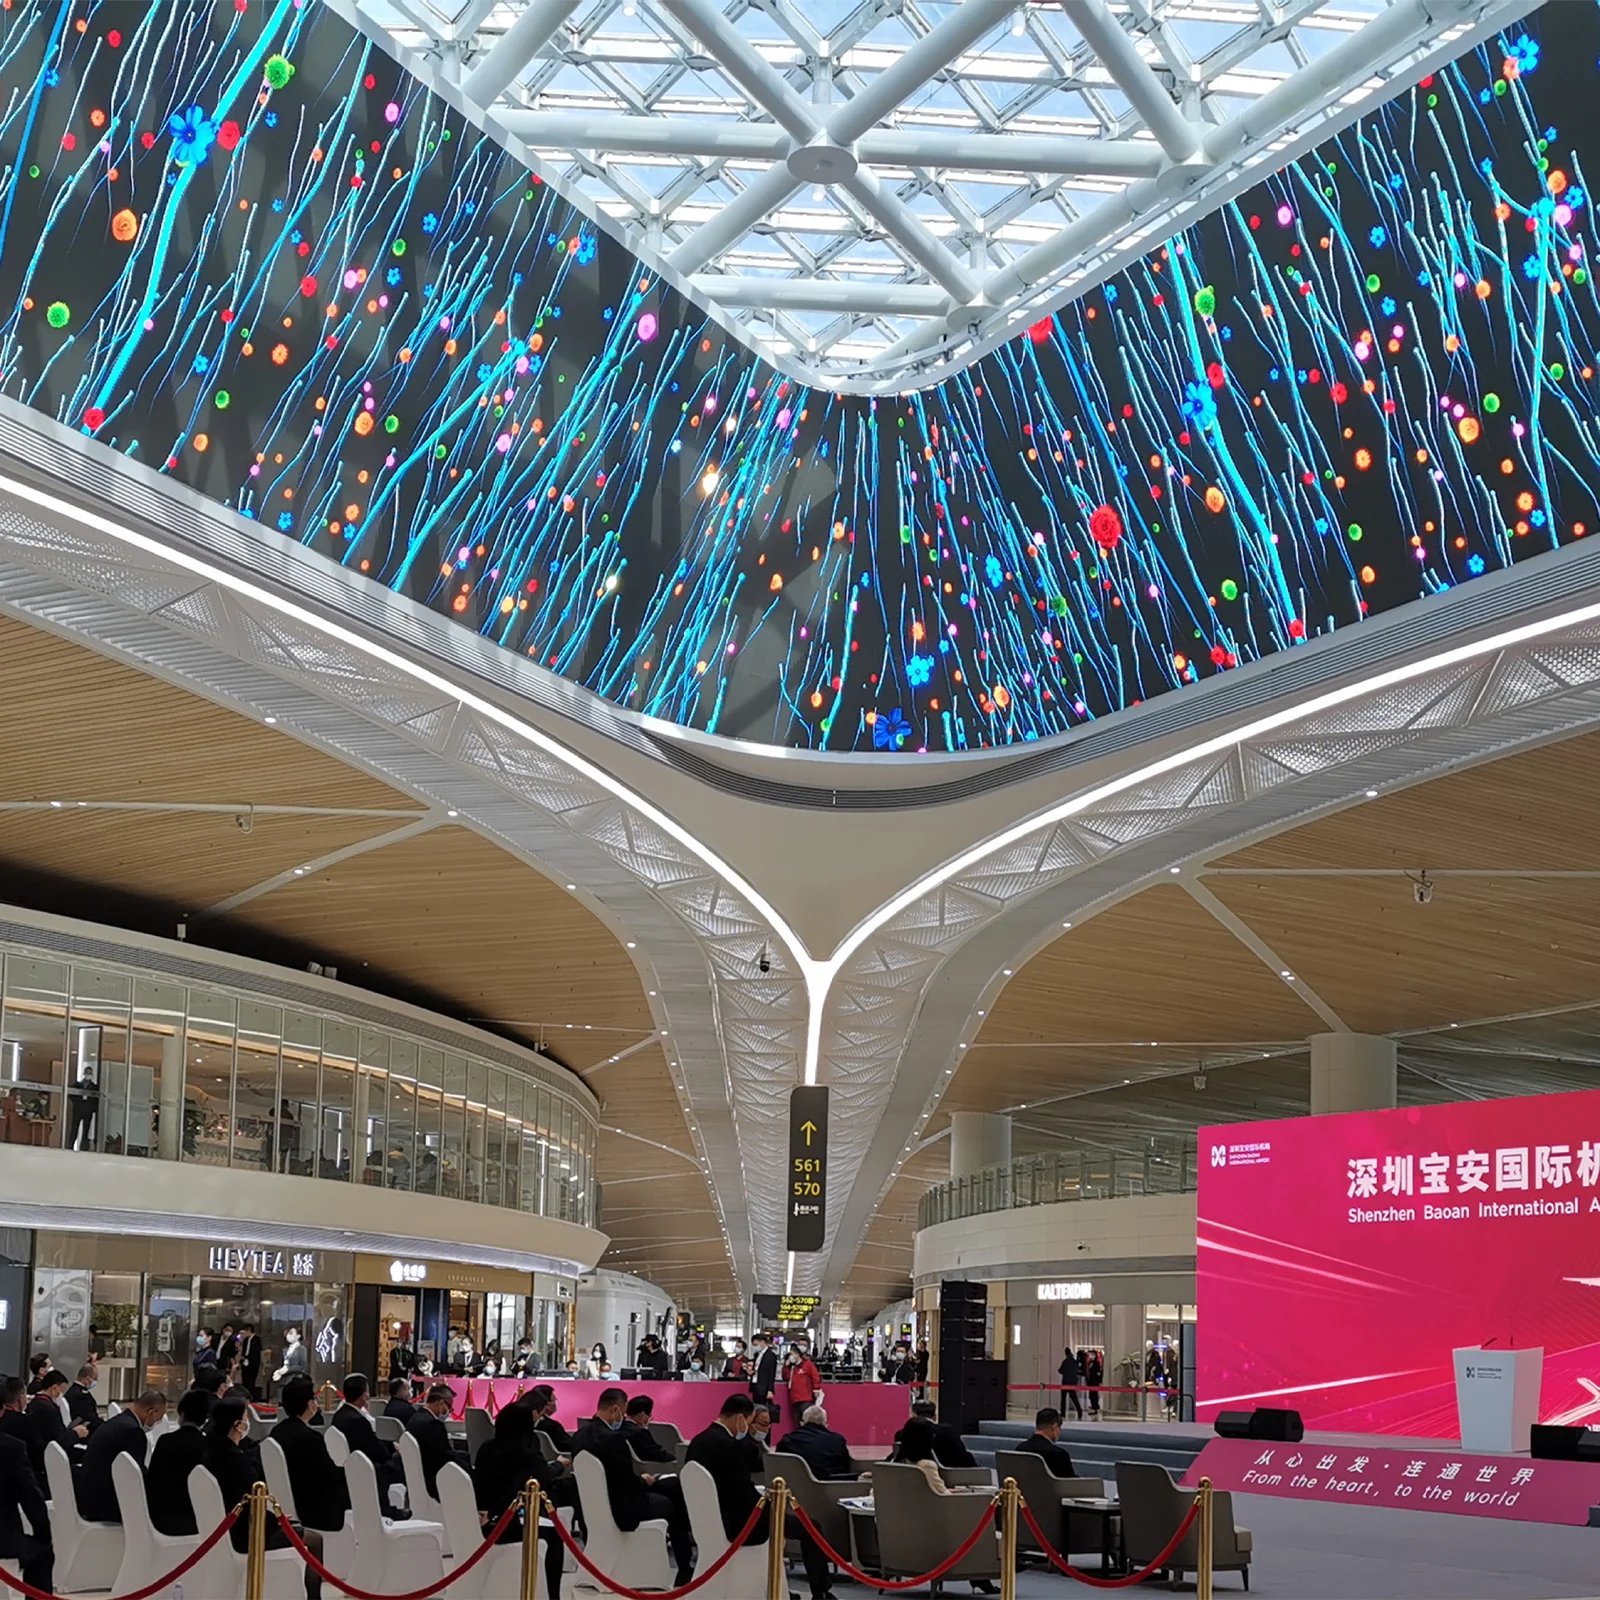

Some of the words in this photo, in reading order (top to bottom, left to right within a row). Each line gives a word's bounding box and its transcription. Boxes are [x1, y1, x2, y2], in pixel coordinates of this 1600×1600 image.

[794, 1158, 820, 1172] 561
[794, 1182, 821, 1196] 570
[1348, 1206, 1416, 1223] Shenzhen
[1423, 1204, 1470, 1220] Baoan
[1478, 1197, 1579, 1218] International
[208, 1246, 285, 1274] HEYTEA
[1037, 1282, 1092, 1300] KALTENDIN
[1242, 1469, 1283, 1486] From
[1289, 1474, 1318, 1489] the
[1324, 1476, 1380, 1497] heart,
[1394, 1483, 1413, 1497] to
[1422, 1485, 1453, 1501] the
[1463, 1490, 1521, 1507] world
